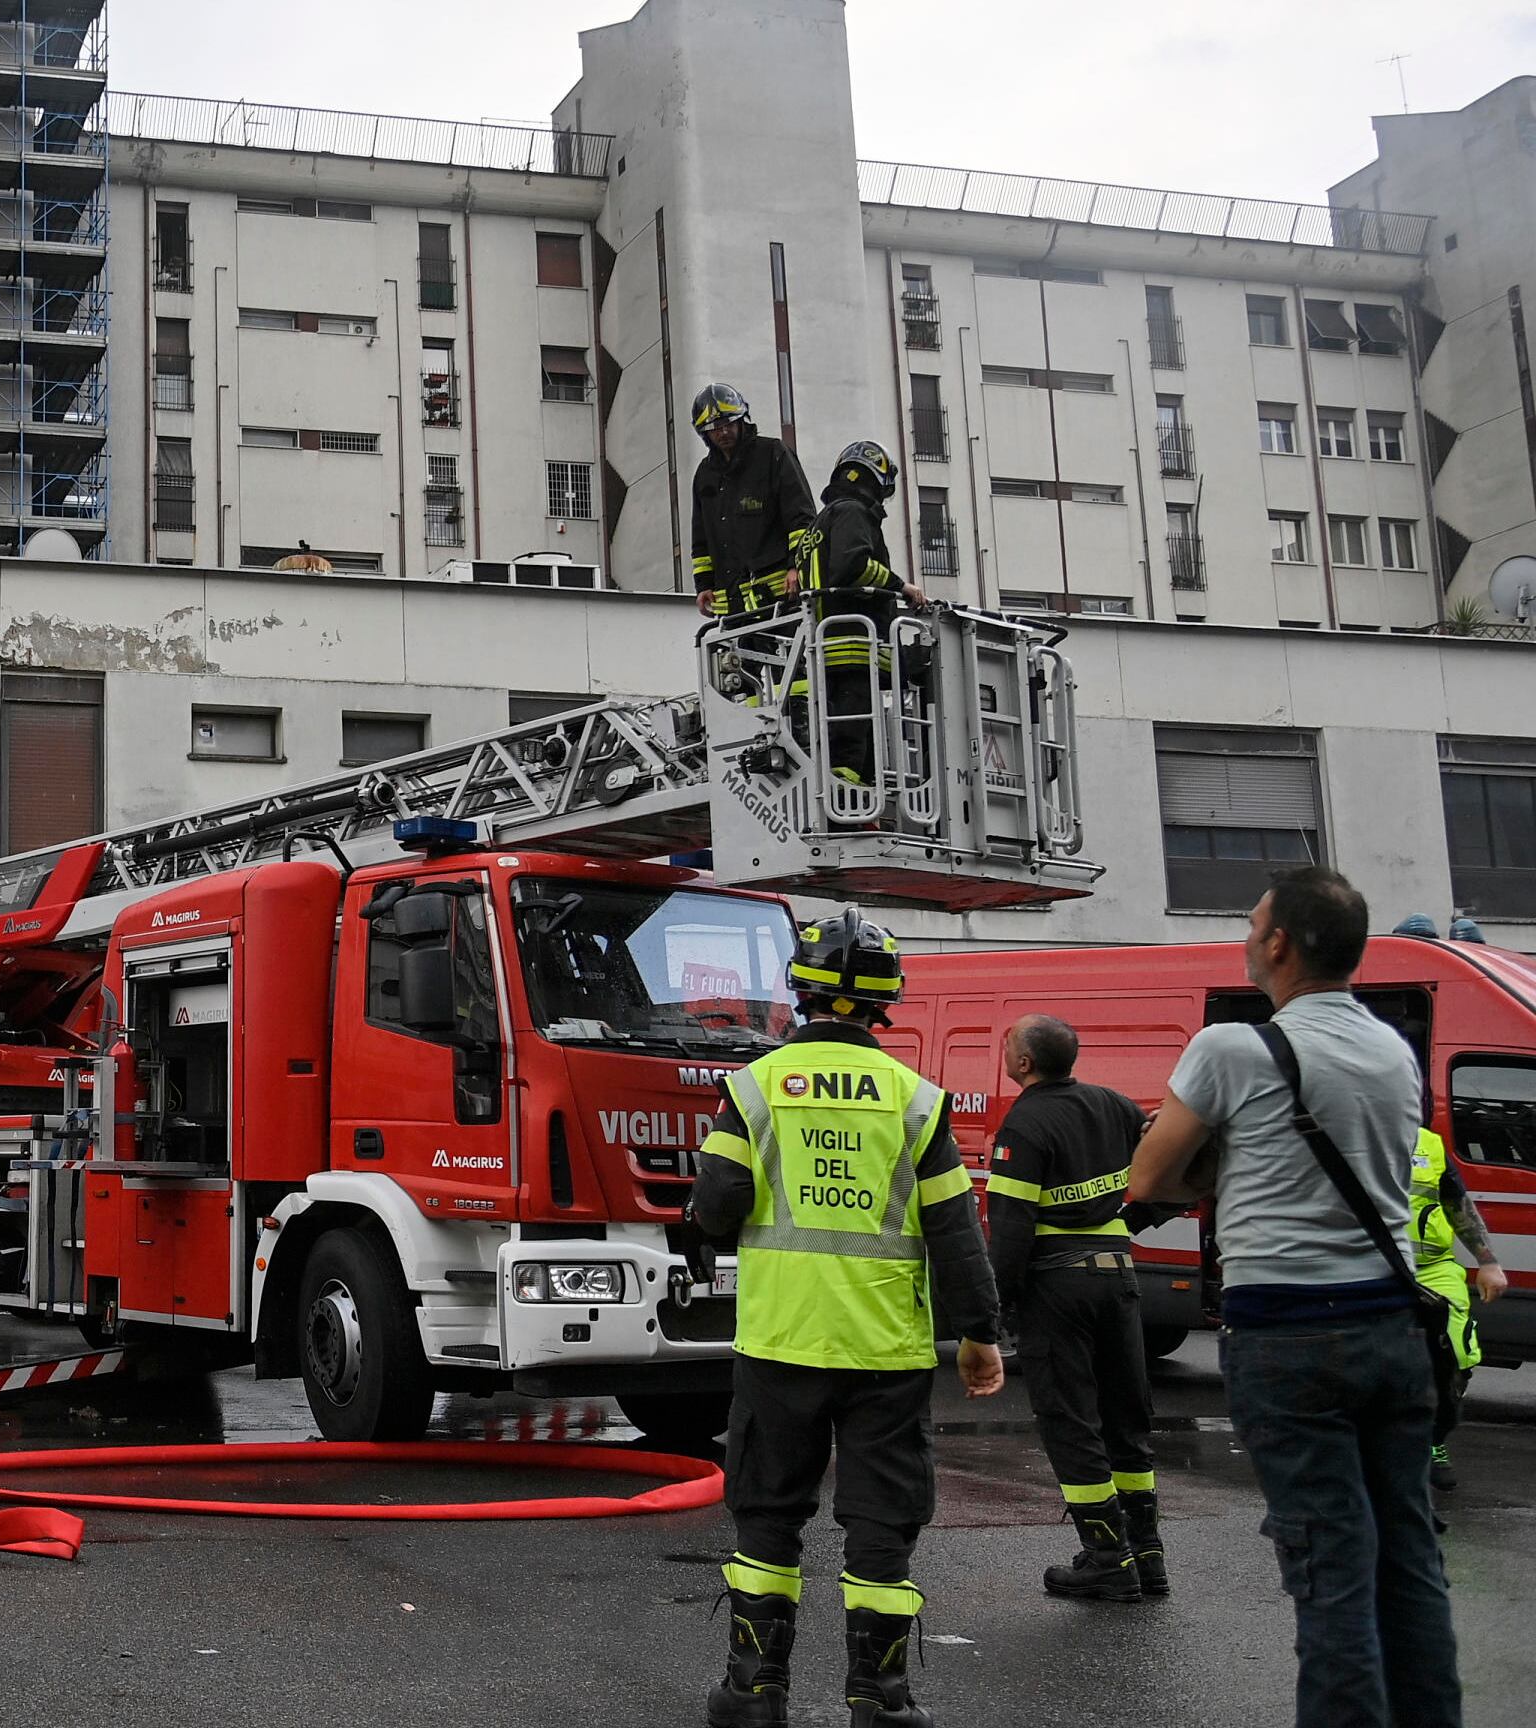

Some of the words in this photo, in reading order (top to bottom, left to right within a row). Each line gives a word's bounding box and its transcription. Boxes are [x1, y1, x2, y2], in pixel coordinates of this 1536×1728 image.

[721, 769, 792, 844] MAGIRUS
[165, 910, 200, 924] MAGIRUS
[701, 977, 737, 995] FUOCO
[812, 1072, 881, 1101] NIA
[598, 1110, 685, 1145] VIGILI
[800, 1127, 861, 1152] VIGILI
[452, 1156, 504, 1169] MAGIRUS
[815, 1158, 856, 1180] DEL
[799, 1185, 873, 1210] FUOCO
[1050, 1184, 1091, 1202] VIGILI
[1091, 1178, 1111, 1195] DEL
